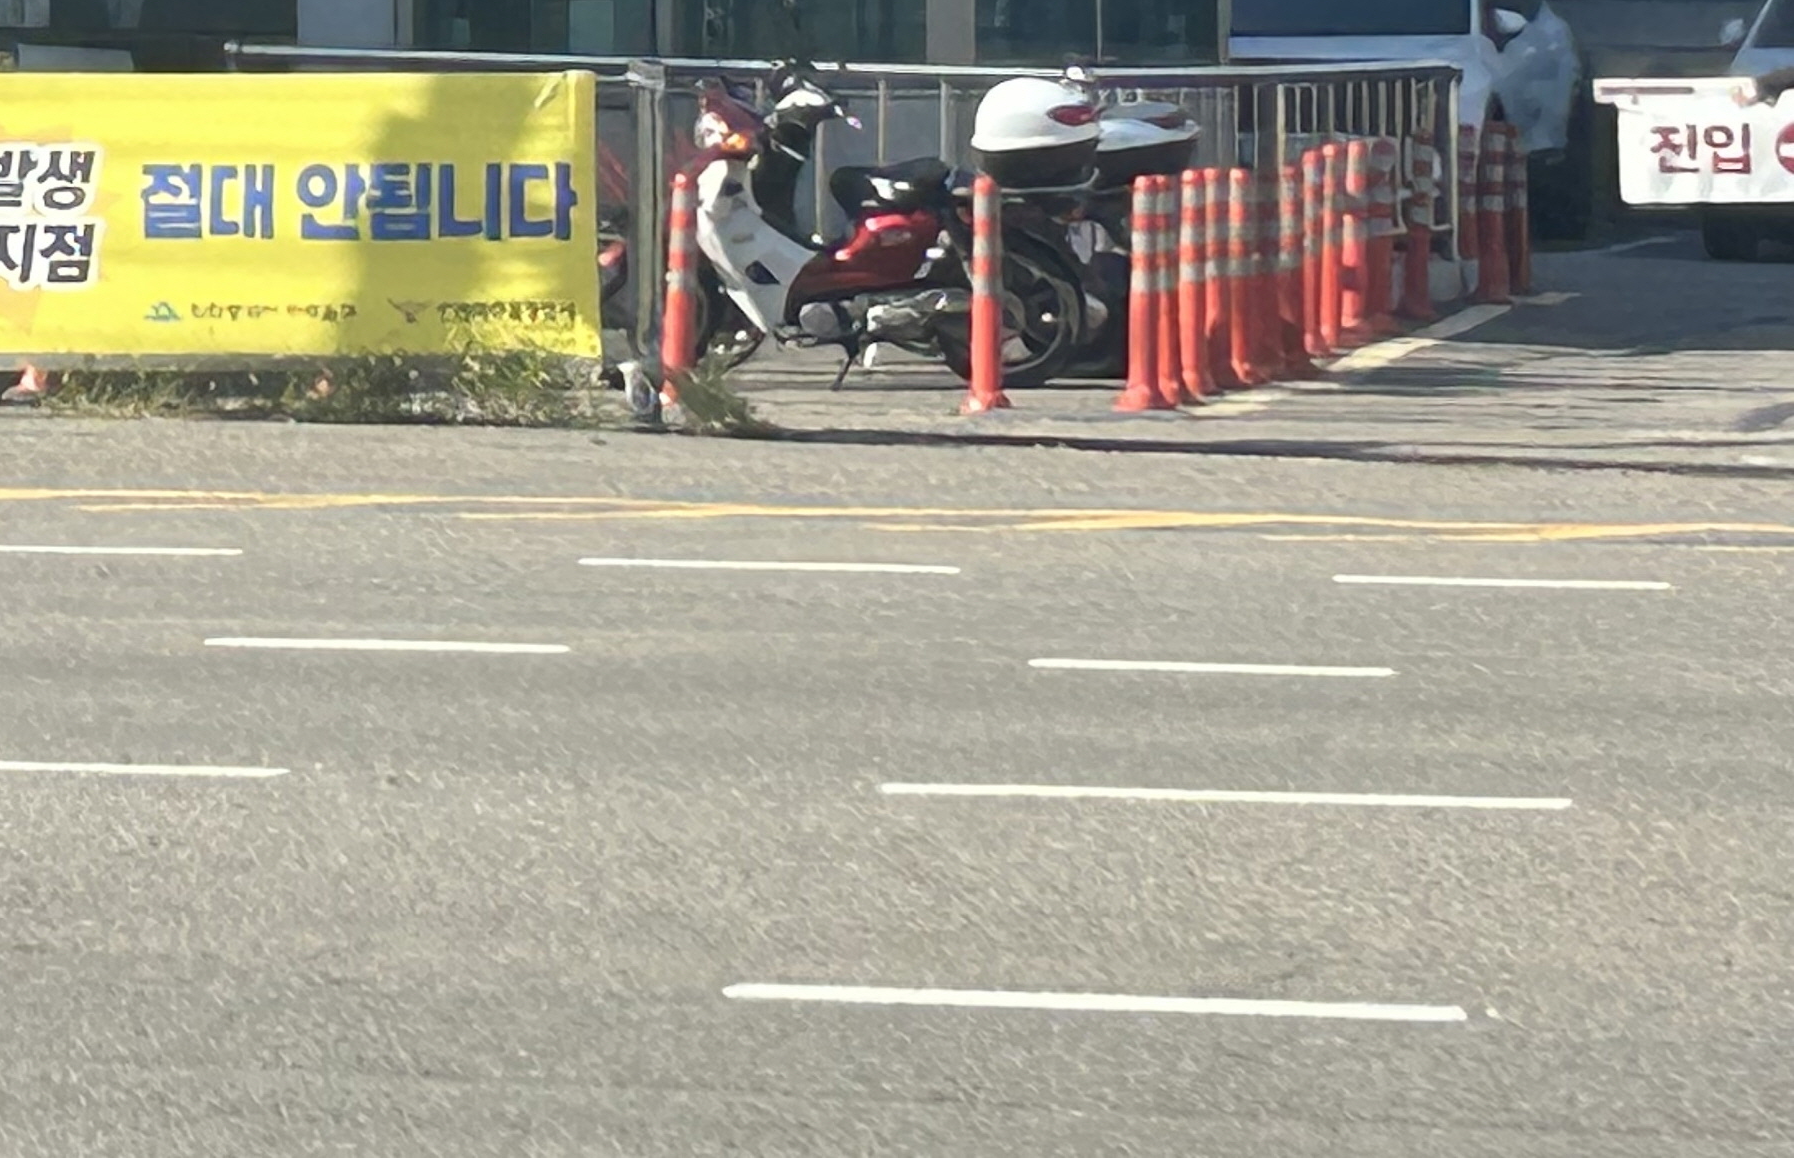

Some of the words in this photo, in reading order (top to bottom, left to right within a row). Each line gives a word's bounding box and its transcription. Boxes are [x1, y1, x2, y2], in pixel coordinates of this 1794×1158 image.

[1650, 123, 1751, 174] 진입
[141, 163, 275, 239] 절대
[296, 162, 578, 241] 안됩니다
